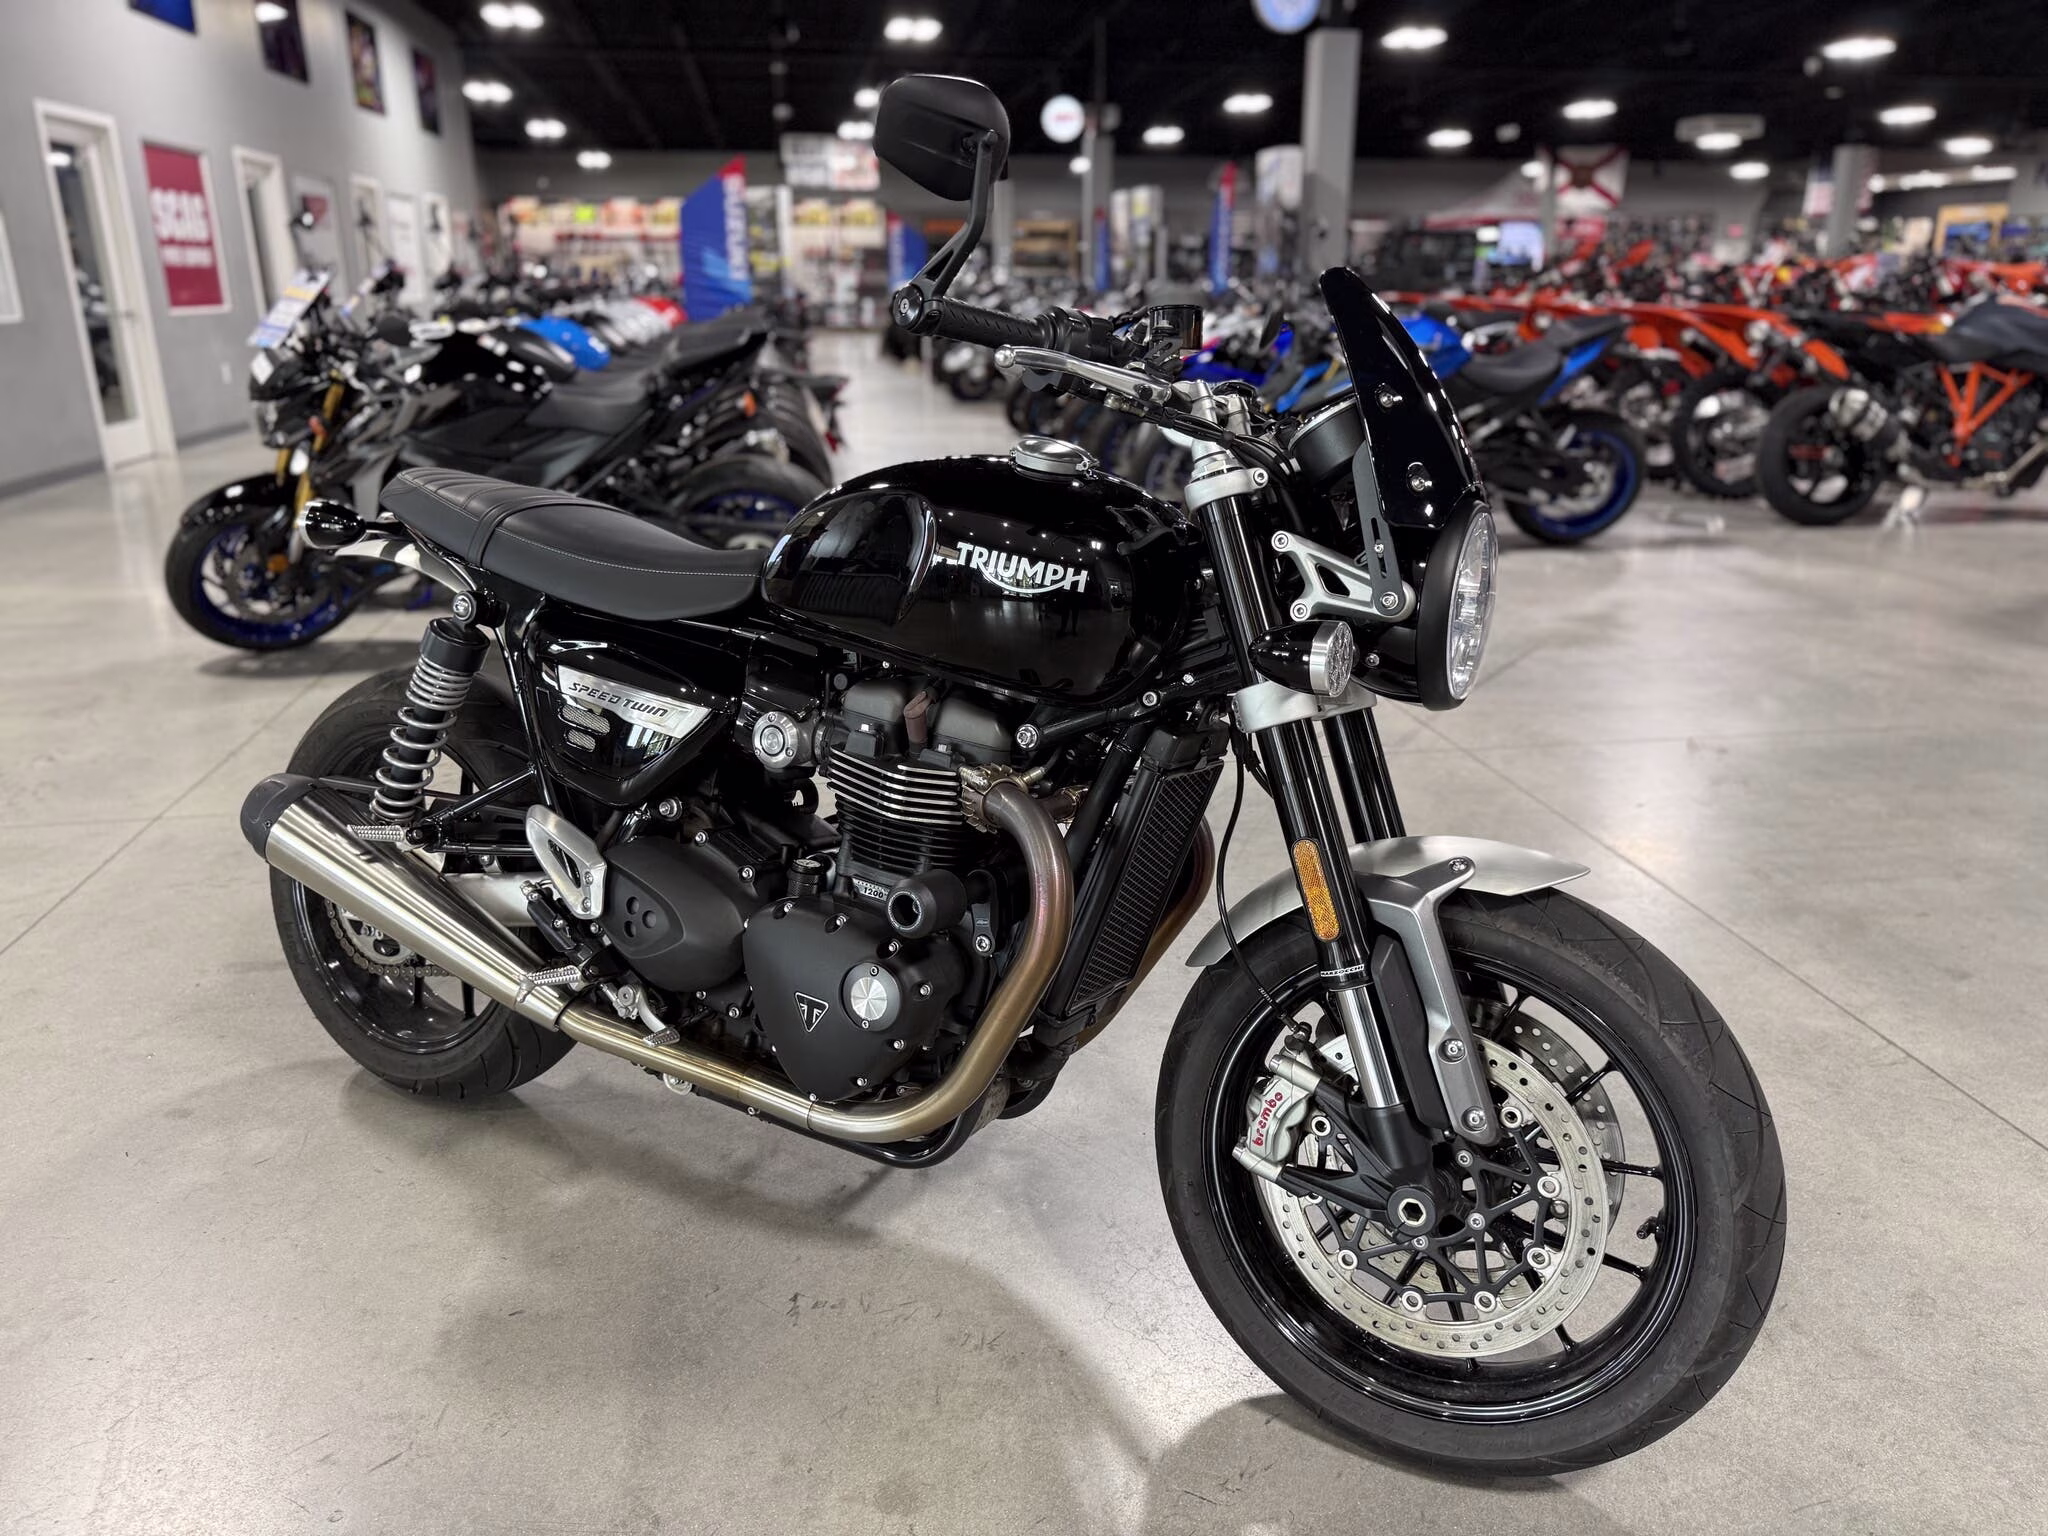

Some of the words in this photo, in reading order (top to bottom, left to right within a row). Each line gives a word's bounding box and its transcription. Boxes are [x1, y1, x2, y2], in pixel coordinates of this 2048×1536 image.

[956, 541, 1088, 593] TRIUMPH
[568, 682, 621, 704] SPEED
[623, 697, 669, 717] TWIN
[863, 886, 884, 899] 1200
[1251, 1091, 1283, 1146] brembo
